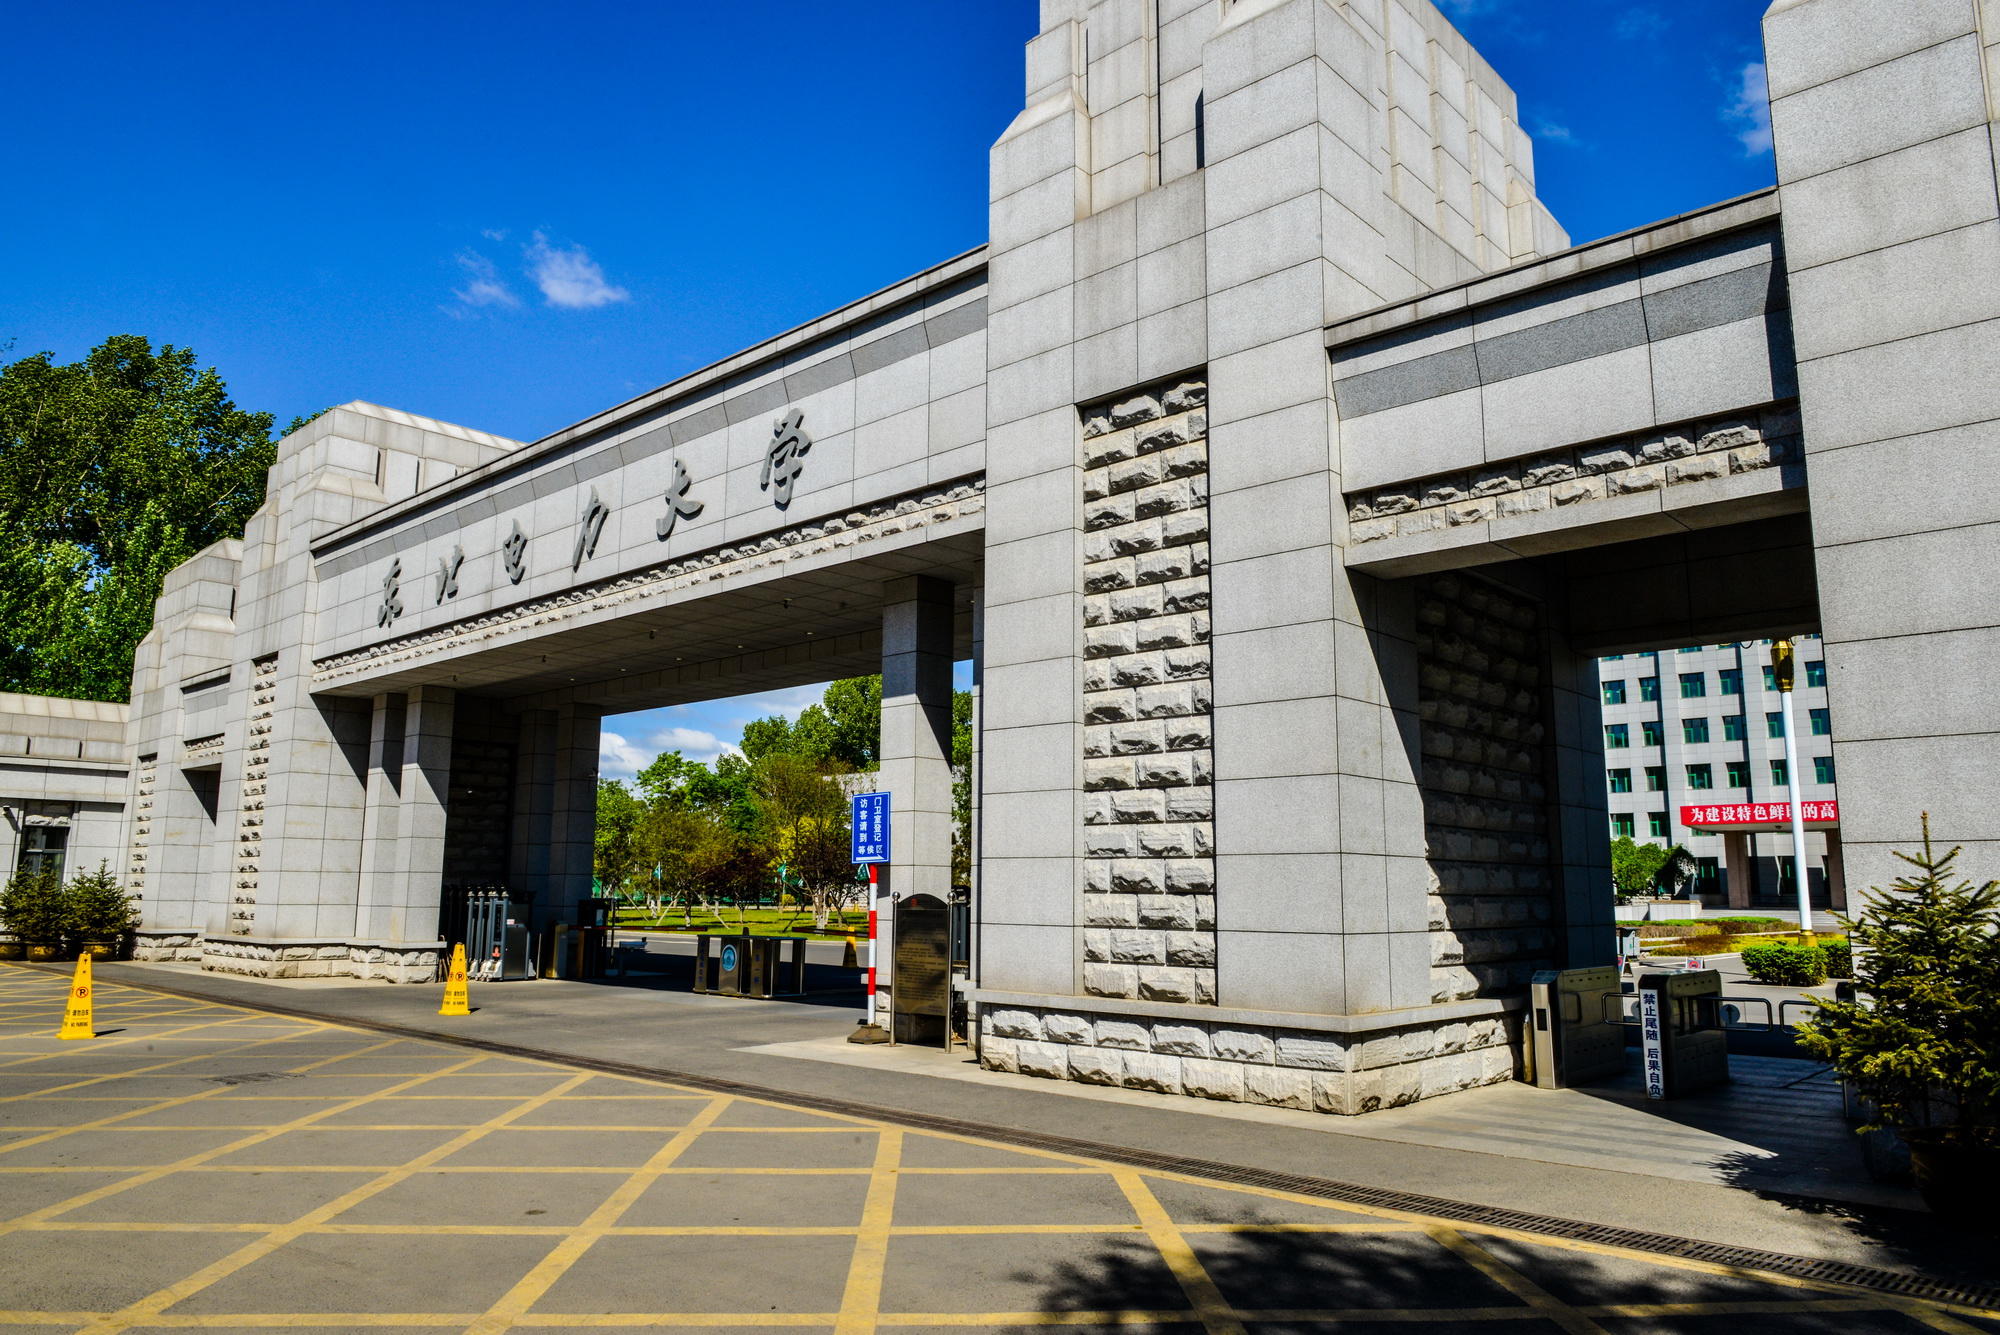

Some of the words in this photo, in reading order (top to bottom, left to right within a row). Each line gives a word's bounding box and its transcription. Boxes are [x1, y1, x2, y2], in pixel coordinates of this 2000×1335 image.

[1643, 993, 1658, 1041] 禁止尾随
[1647, 1048, 1662, 1097] 后果自负
